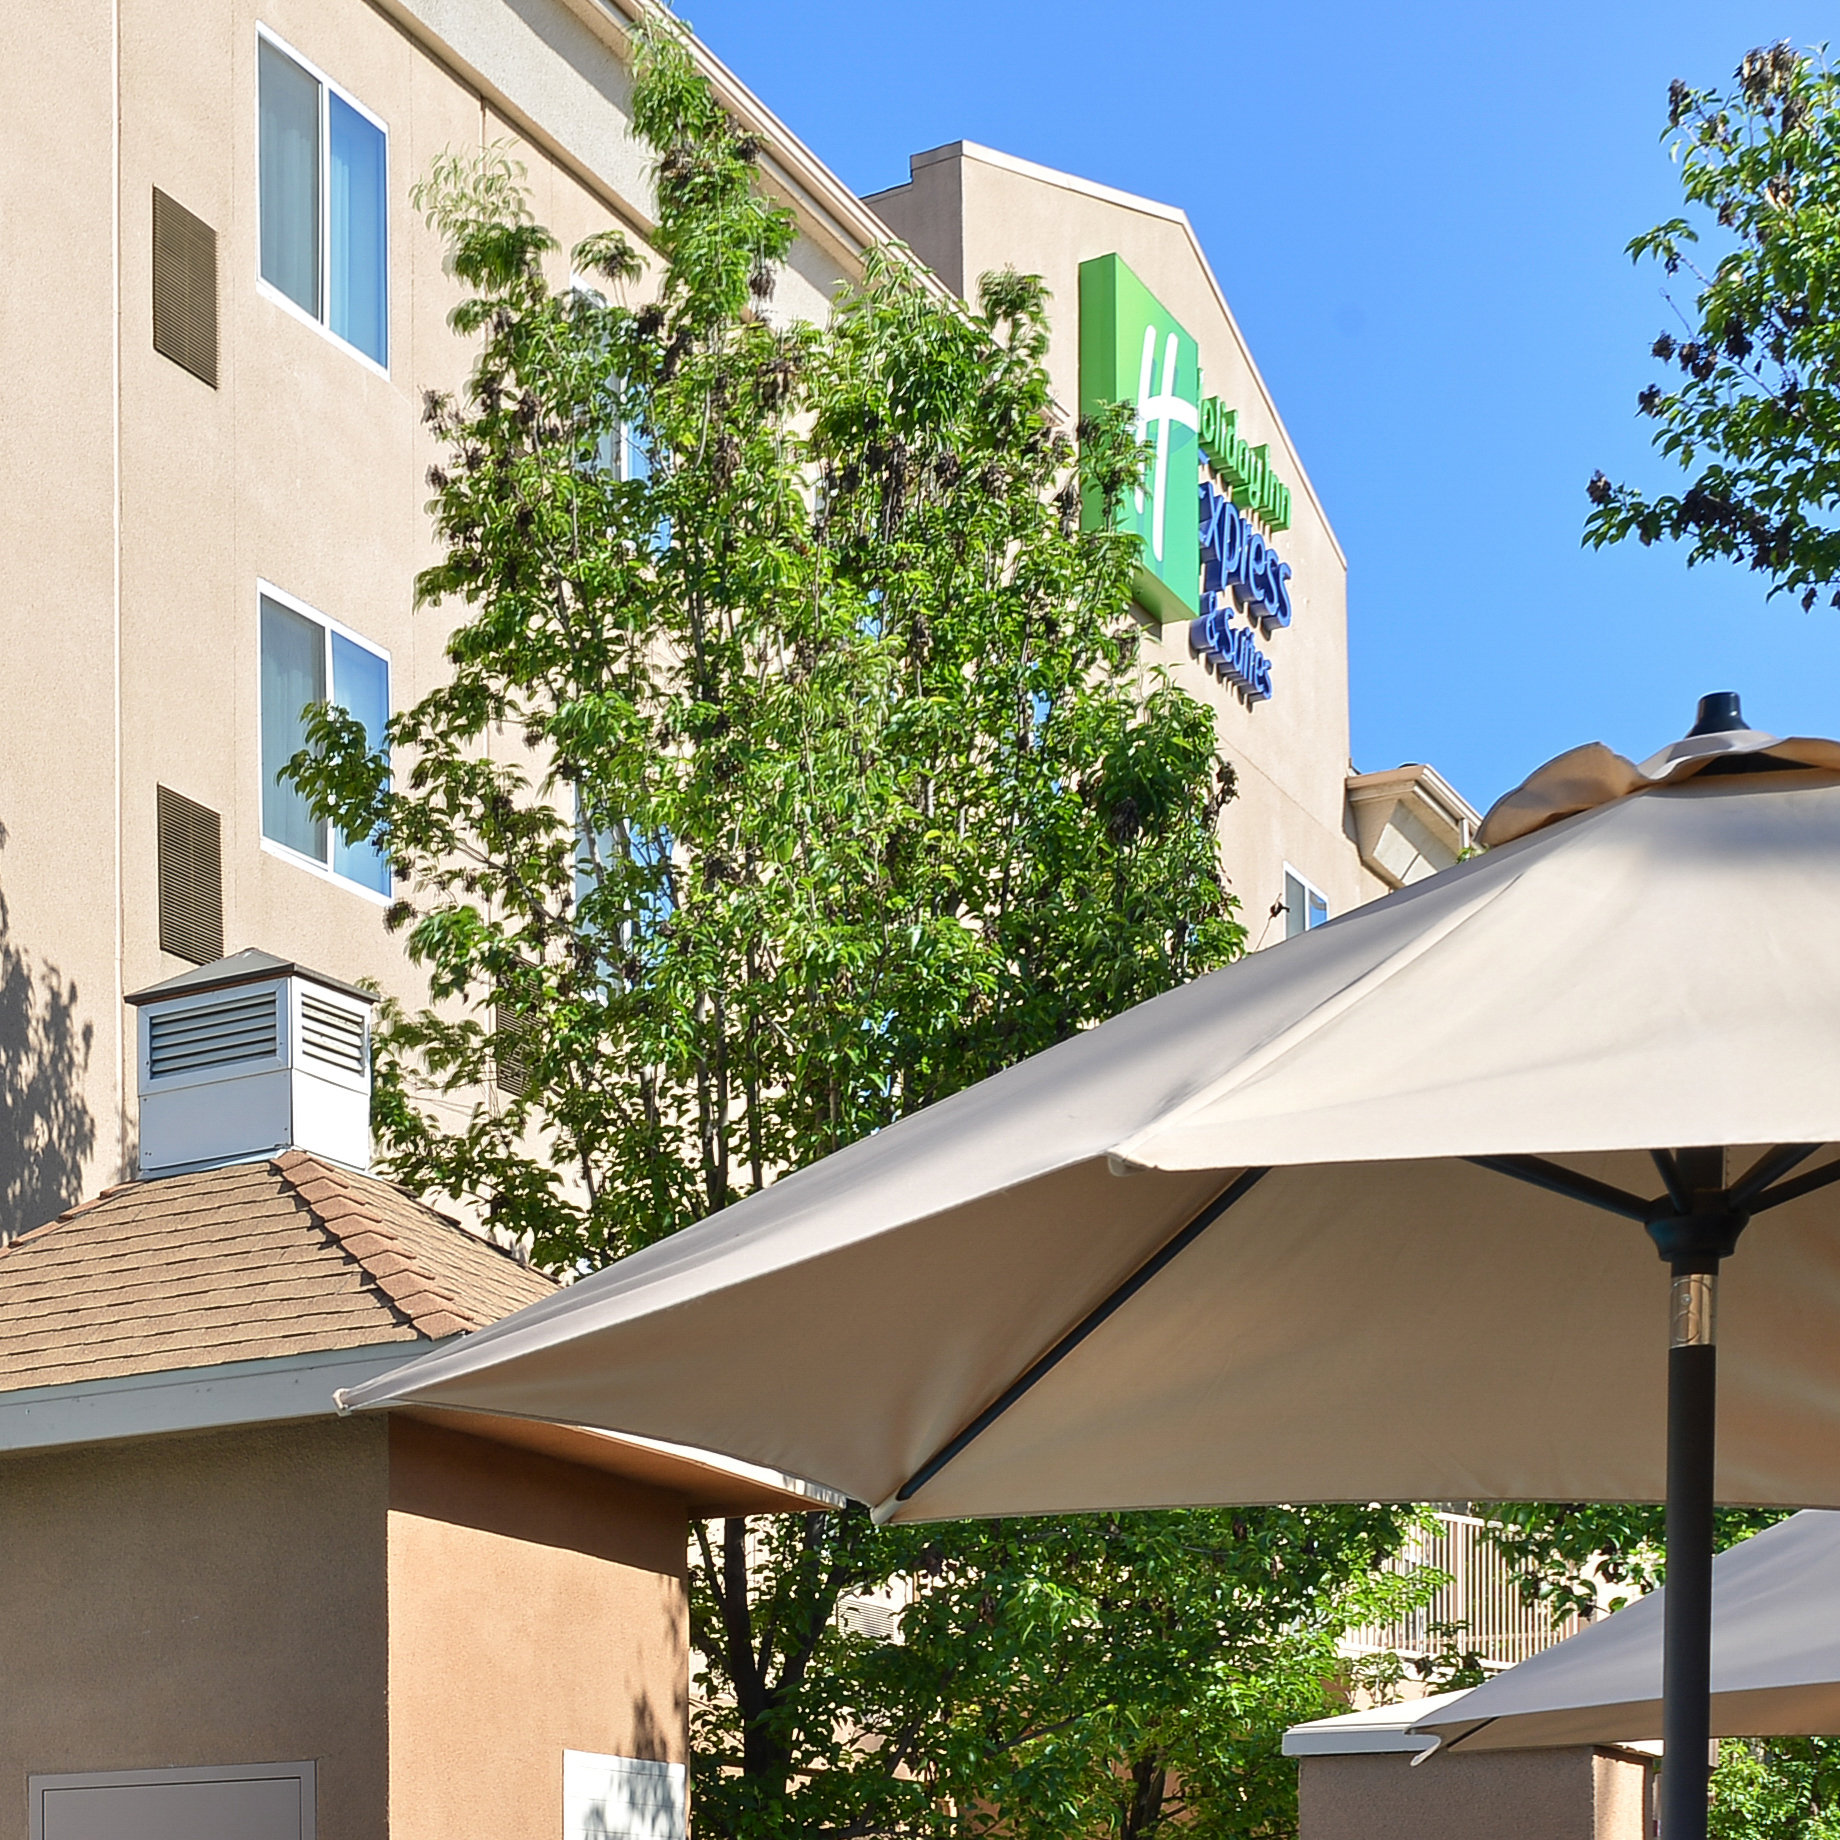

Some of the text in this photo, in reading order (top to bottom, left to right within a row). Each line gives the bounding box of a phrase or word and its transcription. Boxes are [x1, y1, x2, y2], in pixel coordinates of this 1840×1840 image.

[1258, 444, 1292, 533] Inn
[1199, 480, 1292, 628] xpress
[1219, 606, 1272, 699] Suites
